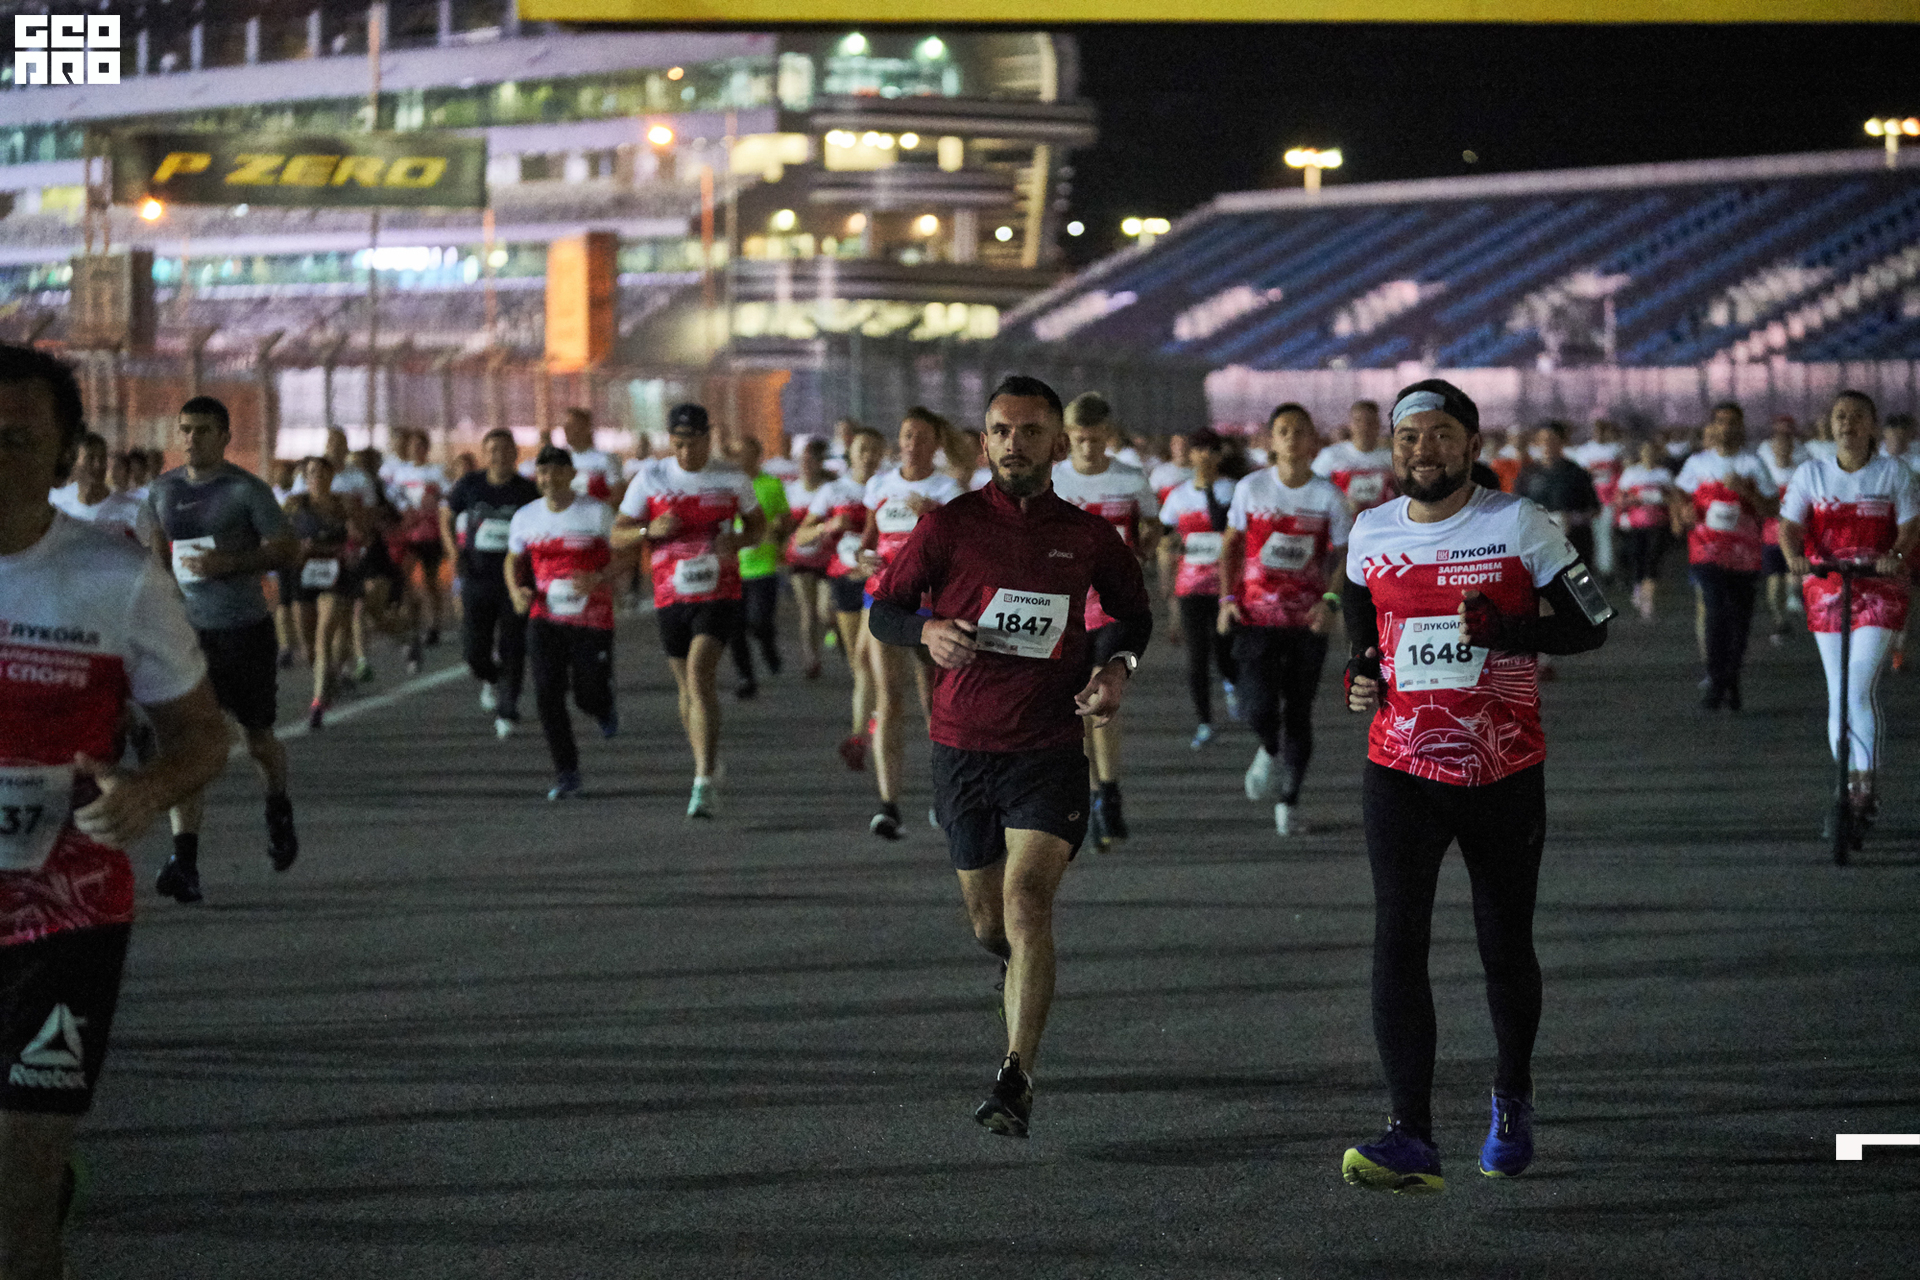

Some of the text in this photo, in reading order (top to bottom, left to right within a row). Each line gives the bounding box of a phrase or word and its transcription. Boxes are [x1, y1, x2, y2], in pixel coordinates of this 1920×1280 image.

[152, 151, 448, 188] P ZERO
[1450, 543, 1507, 559] ЛУКОЙЛ
[1438, 562, 1503, 574] ЗАПРАВЛЯЕМ
[1437, 572, 1502, 586] В СПОРТЕ
[1013, 595, 1051, 606] ЛУКОЙЛ
[995, 612, 1053, 636] 1847
[1408, 642, 1473, 665] 1648
